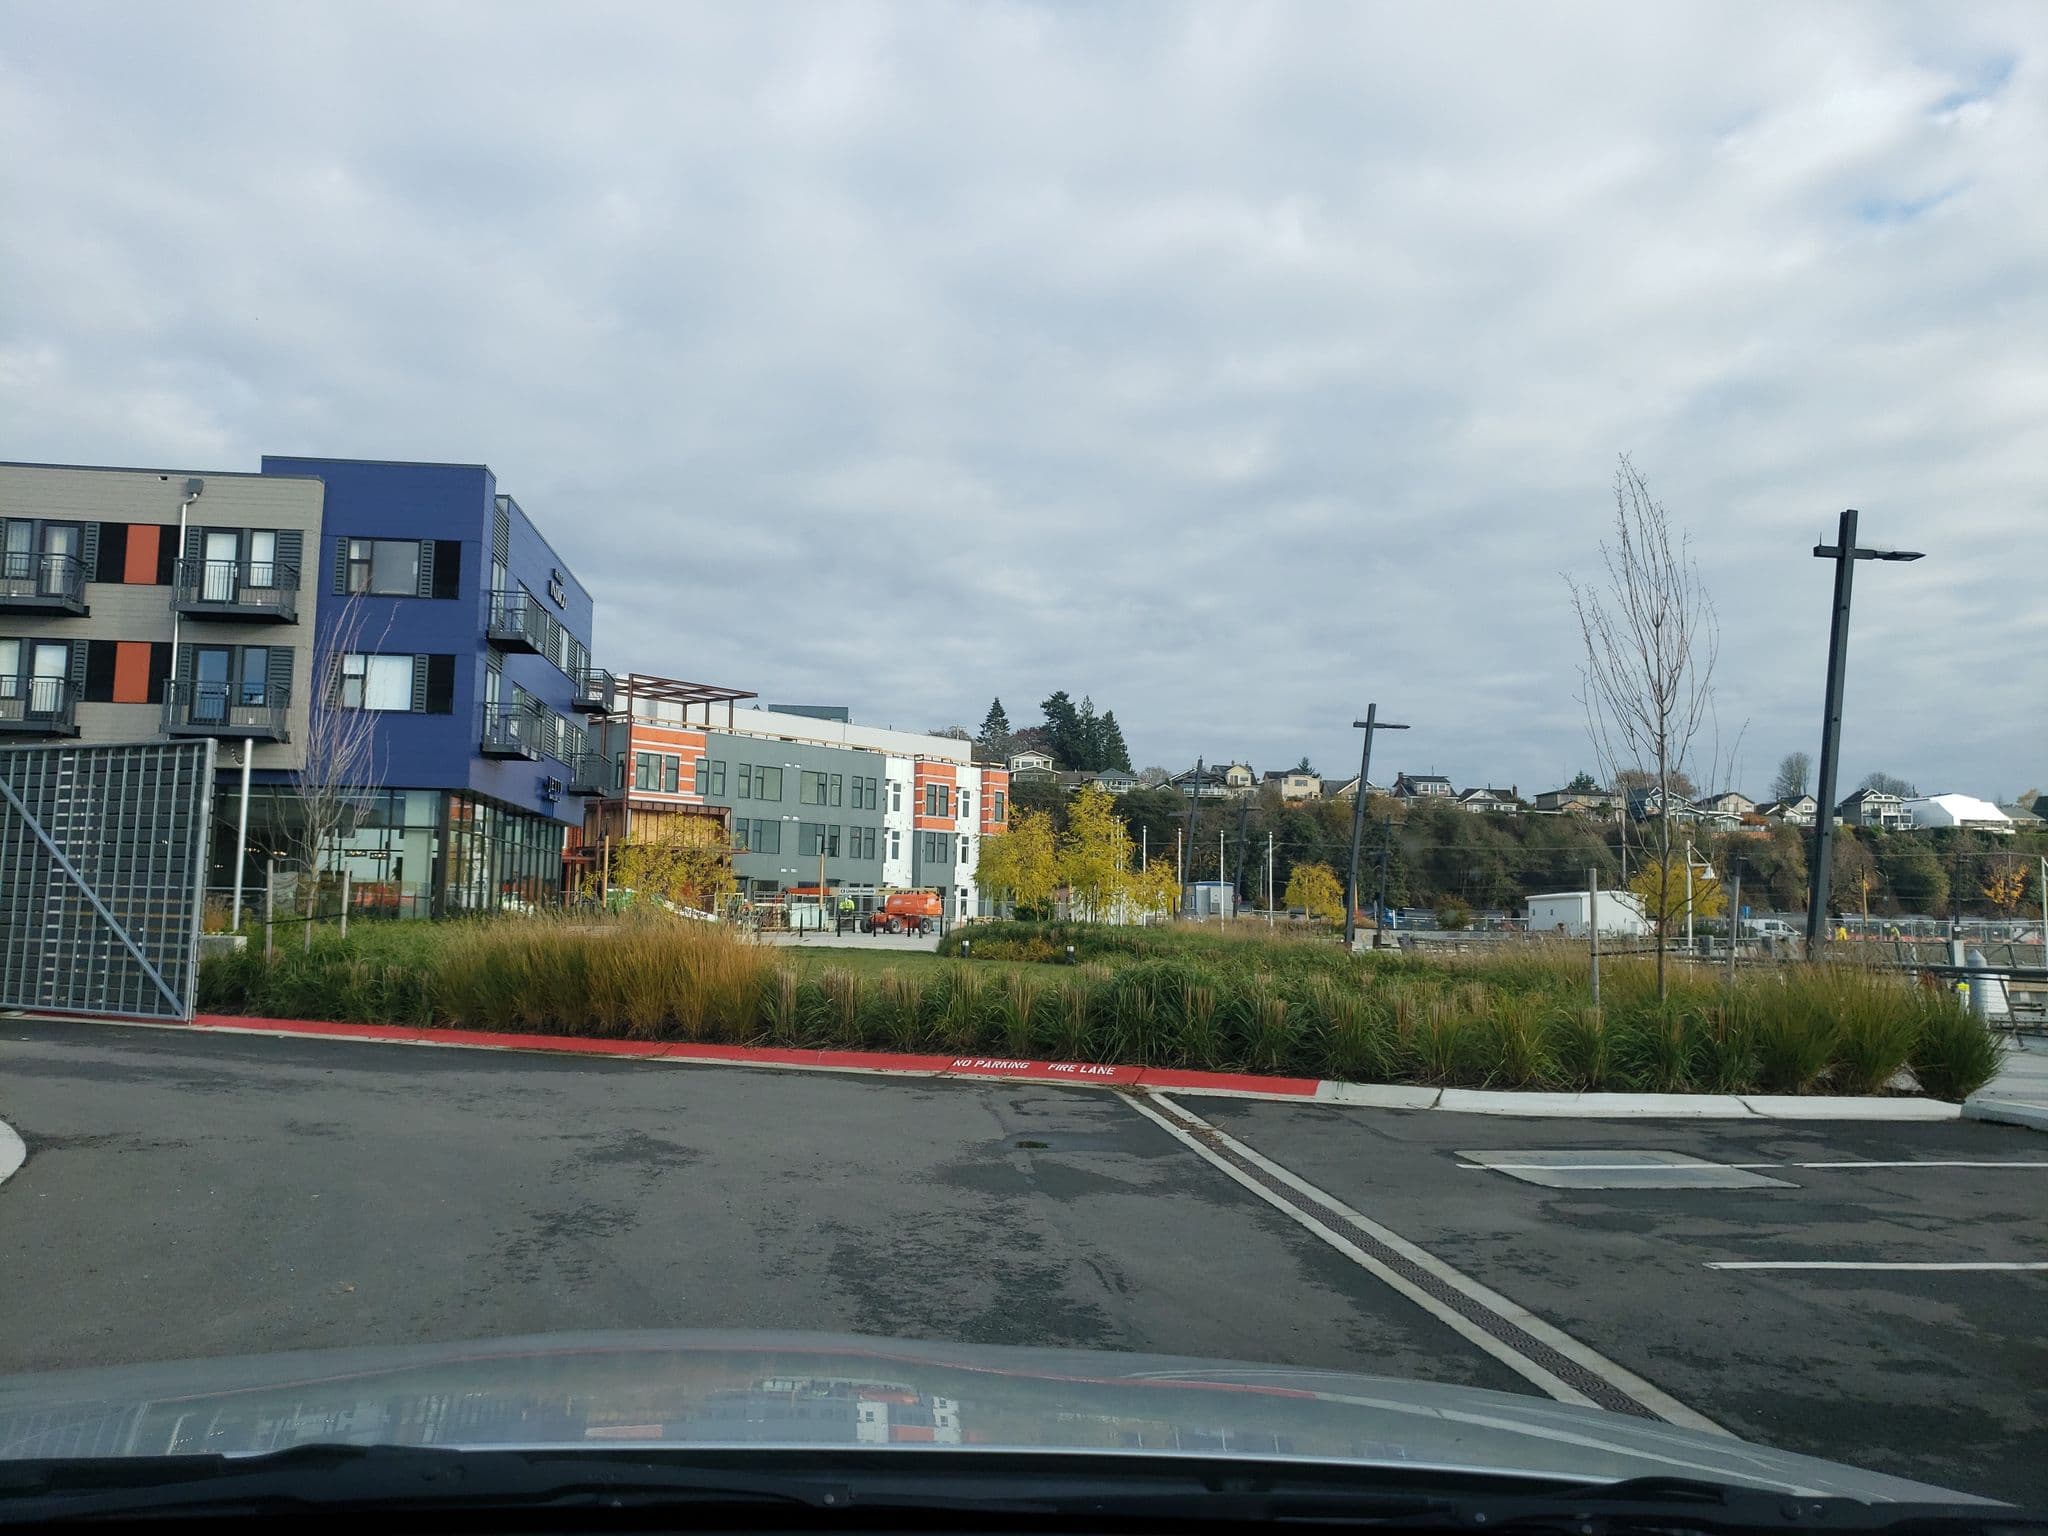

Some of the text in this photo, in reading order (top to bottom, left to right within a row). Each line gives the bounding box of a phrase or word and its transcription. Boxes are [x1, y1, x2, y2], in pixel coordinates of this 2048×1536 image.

[952, 1058, 1116, 1076] NO PARKING FIRE LANE
